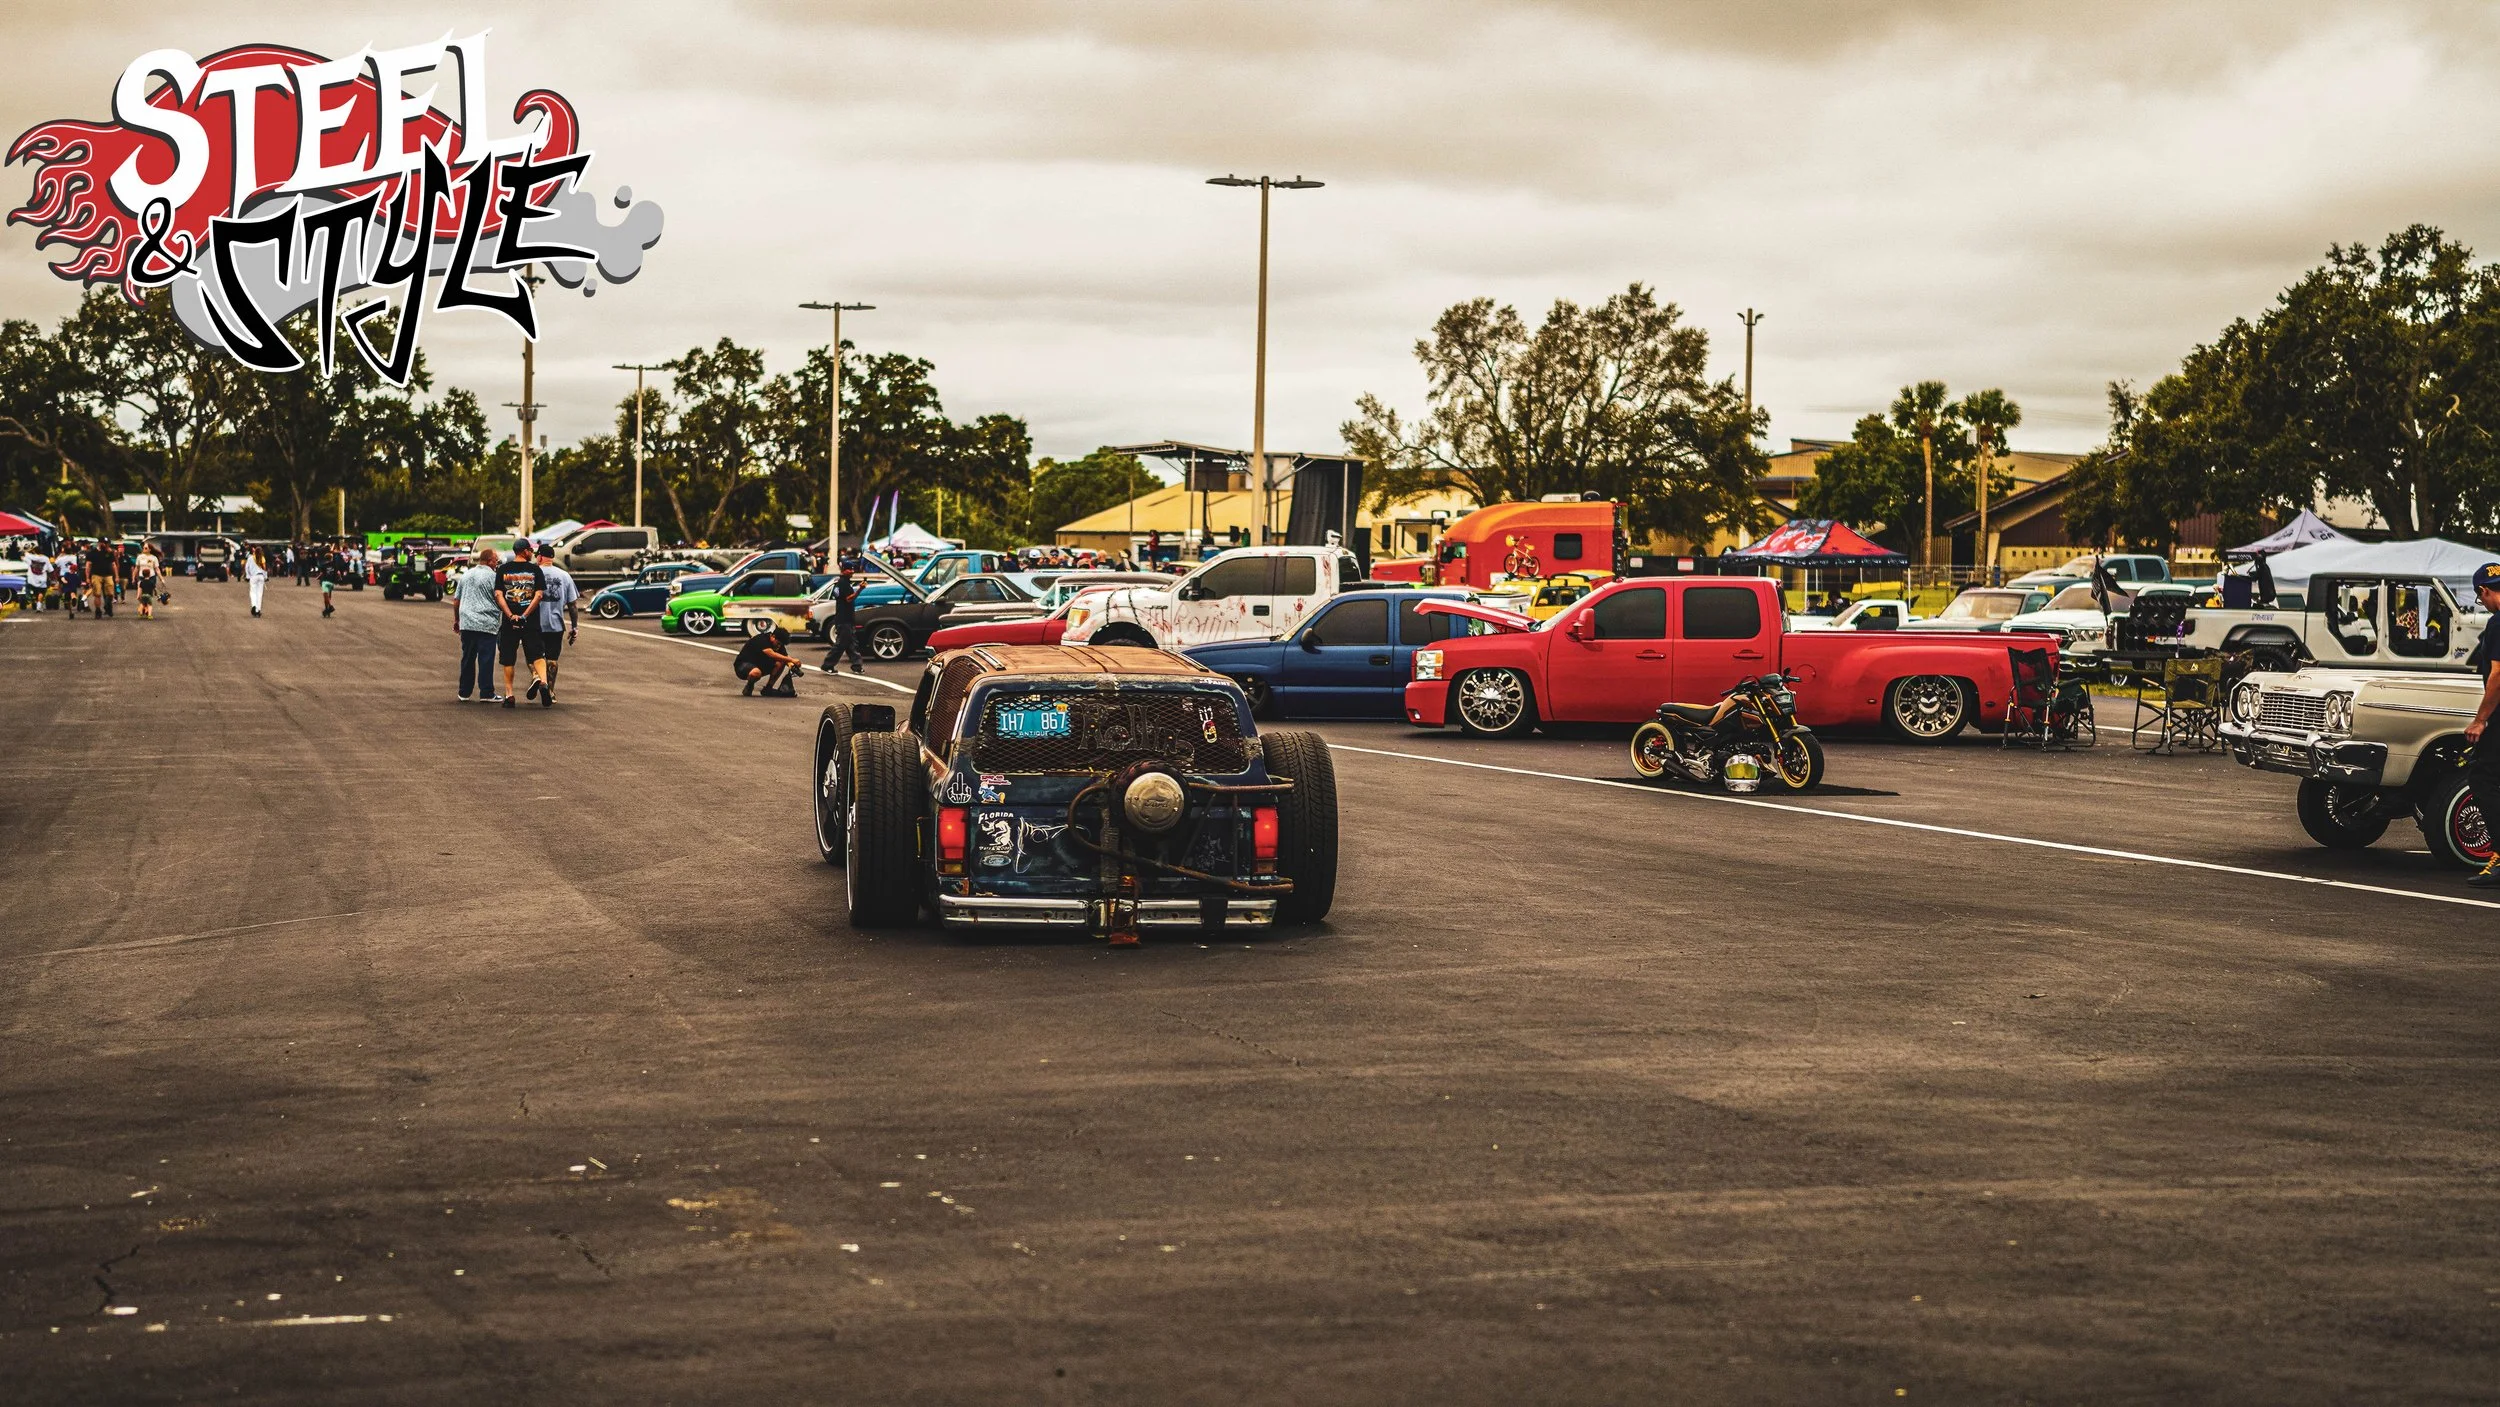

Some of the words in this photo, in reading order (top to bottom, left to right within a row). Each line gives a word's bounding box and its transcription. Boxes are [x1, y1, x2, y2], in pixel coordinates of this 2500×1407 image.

[1000, 712, 1025, 731] IH7
[1041, 712, 1066, 730] 867
[978, 812, 1014, 824] FLORIDA
